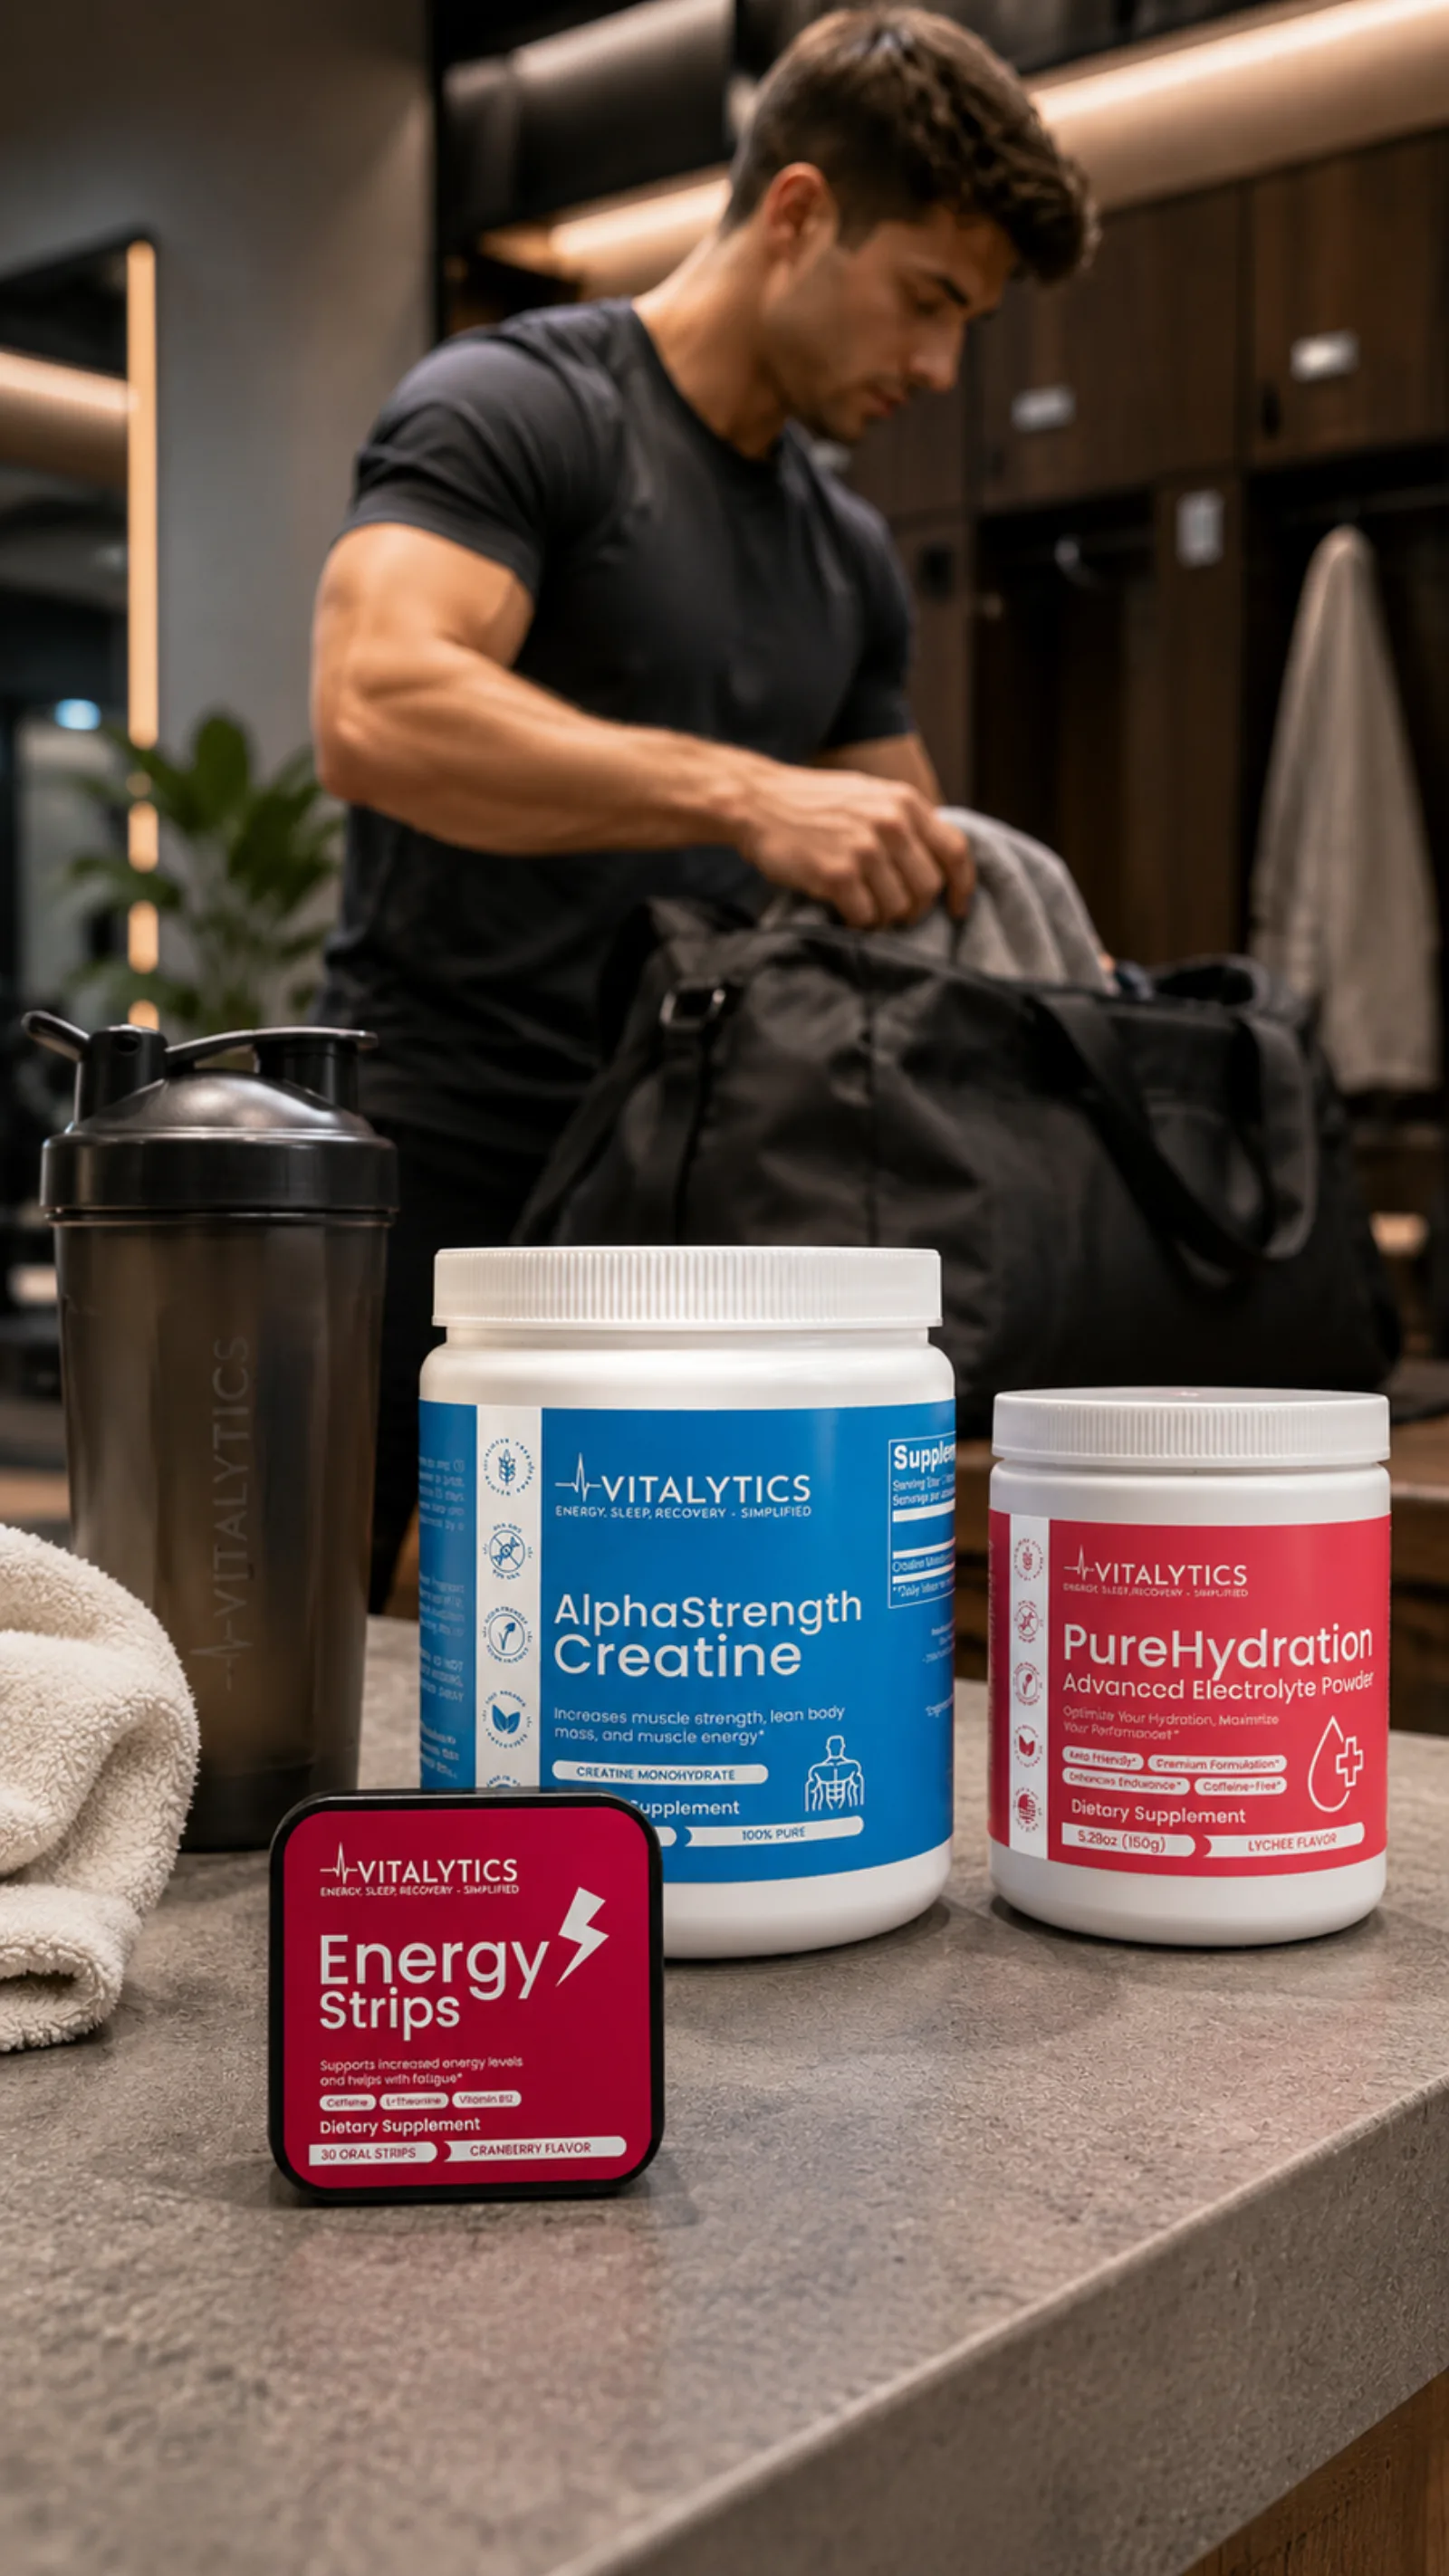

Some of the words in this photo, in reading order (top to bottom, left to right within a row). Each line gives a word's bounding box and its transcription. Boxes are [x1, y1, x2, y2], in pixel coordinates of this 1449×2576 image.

[212, 1336, 250, 1618] VITALYTICS
[601, 1475, 811, 1504] VITALYTICS
[656, 1507, 726, 1518] RECOVERY
[741, 1505, 811, 1518] SIMPLIFIED
[1095, 1562, 1247, 1586] VITALYTICS
[554, 1590, 862, 1635] AlphaStrength
[554, 1633, 801, 1677] Creatine
[1064, 1623, 1373, 1681] PureHydration
[1193, 1680, 1316, 1704] Electrolyte
[1321, 1671, 1374, 1696] Powder
[554, 1707, 627, 1724] Increases
[632, 1710, 690, 1726] muscle
[695, 1710, 767, 1729] strength,
[770, 1708, 803, 1723] lean
[808, 1705, 846, 1722] body
[1118, 1711, 1145, 1724] Your
[554, 1728, 598, 1743] mass,
[603, 1728, 632, 1742] and
[638, 1729, 696, 1743] muscle
[577, 1766, 635, 1780] CREATINE
[638, 1767, 736, 1782] MONOHYDRATE
[1071, 1798, 1129, 1823] Dietary
[1135, 1805, 1246, 1827] Supplement
[742, 1829, 772, 1842] 100%
[776, 1826, 806, 1840] PURE
[1121, 1834, 1166, 1853] (150g)
[1248, 1837, 1293, 1852] LYCHEE
[1297, 1833, 1338, 1849] FLAVOR
[357, 1859, 517, 1883] VITALYTICS
[321, 1935, 550, 2000] Energy
[320, 1987, 460, 2041] Strips
[320, 2059, 375, 2073] Supports
[379, 2057, 440, 2071] increased
[320, 2073, 345, 2087] and
[320, 2119, 379, 2137] Dietary
[381, 2117, 481, 2136] Supplement
[321, 2148, 336, 2161] 30
[340, 2148, 371, 2160] ORAL
[374, 2147, 417, 2159] STRIPS
[469, 2143, 542, 2157] CRANBERRY
[545, 2140, 591, 2154] FLAVOR
